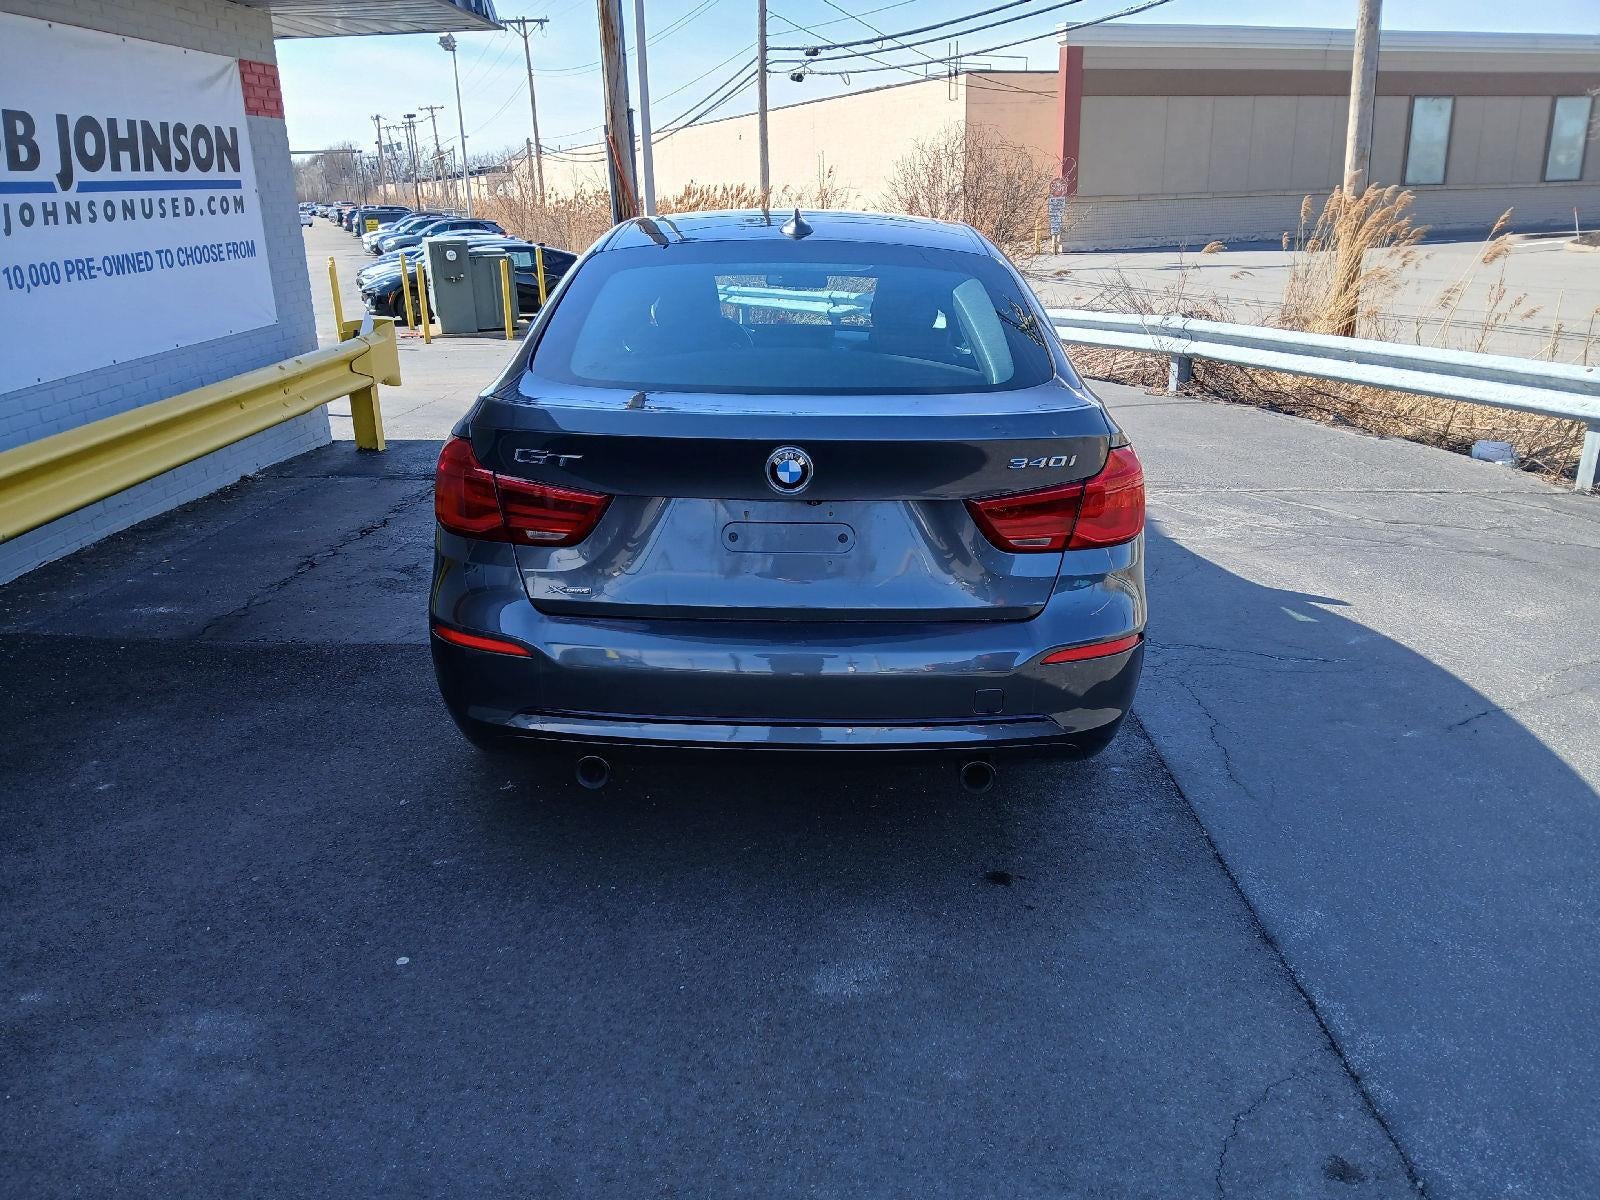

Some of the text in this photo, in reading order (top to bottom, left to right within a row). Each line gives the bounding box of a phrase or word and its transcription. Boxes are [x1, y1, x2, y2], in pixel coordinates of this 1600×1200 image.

[0, 109, 241, 191] B JOHNSON
[3, 195, 245, 236] JOHNSONUSED.COM
[2, 240, 257, 293] 10,000 PRE-OWNED TO CHOOSE FROM
